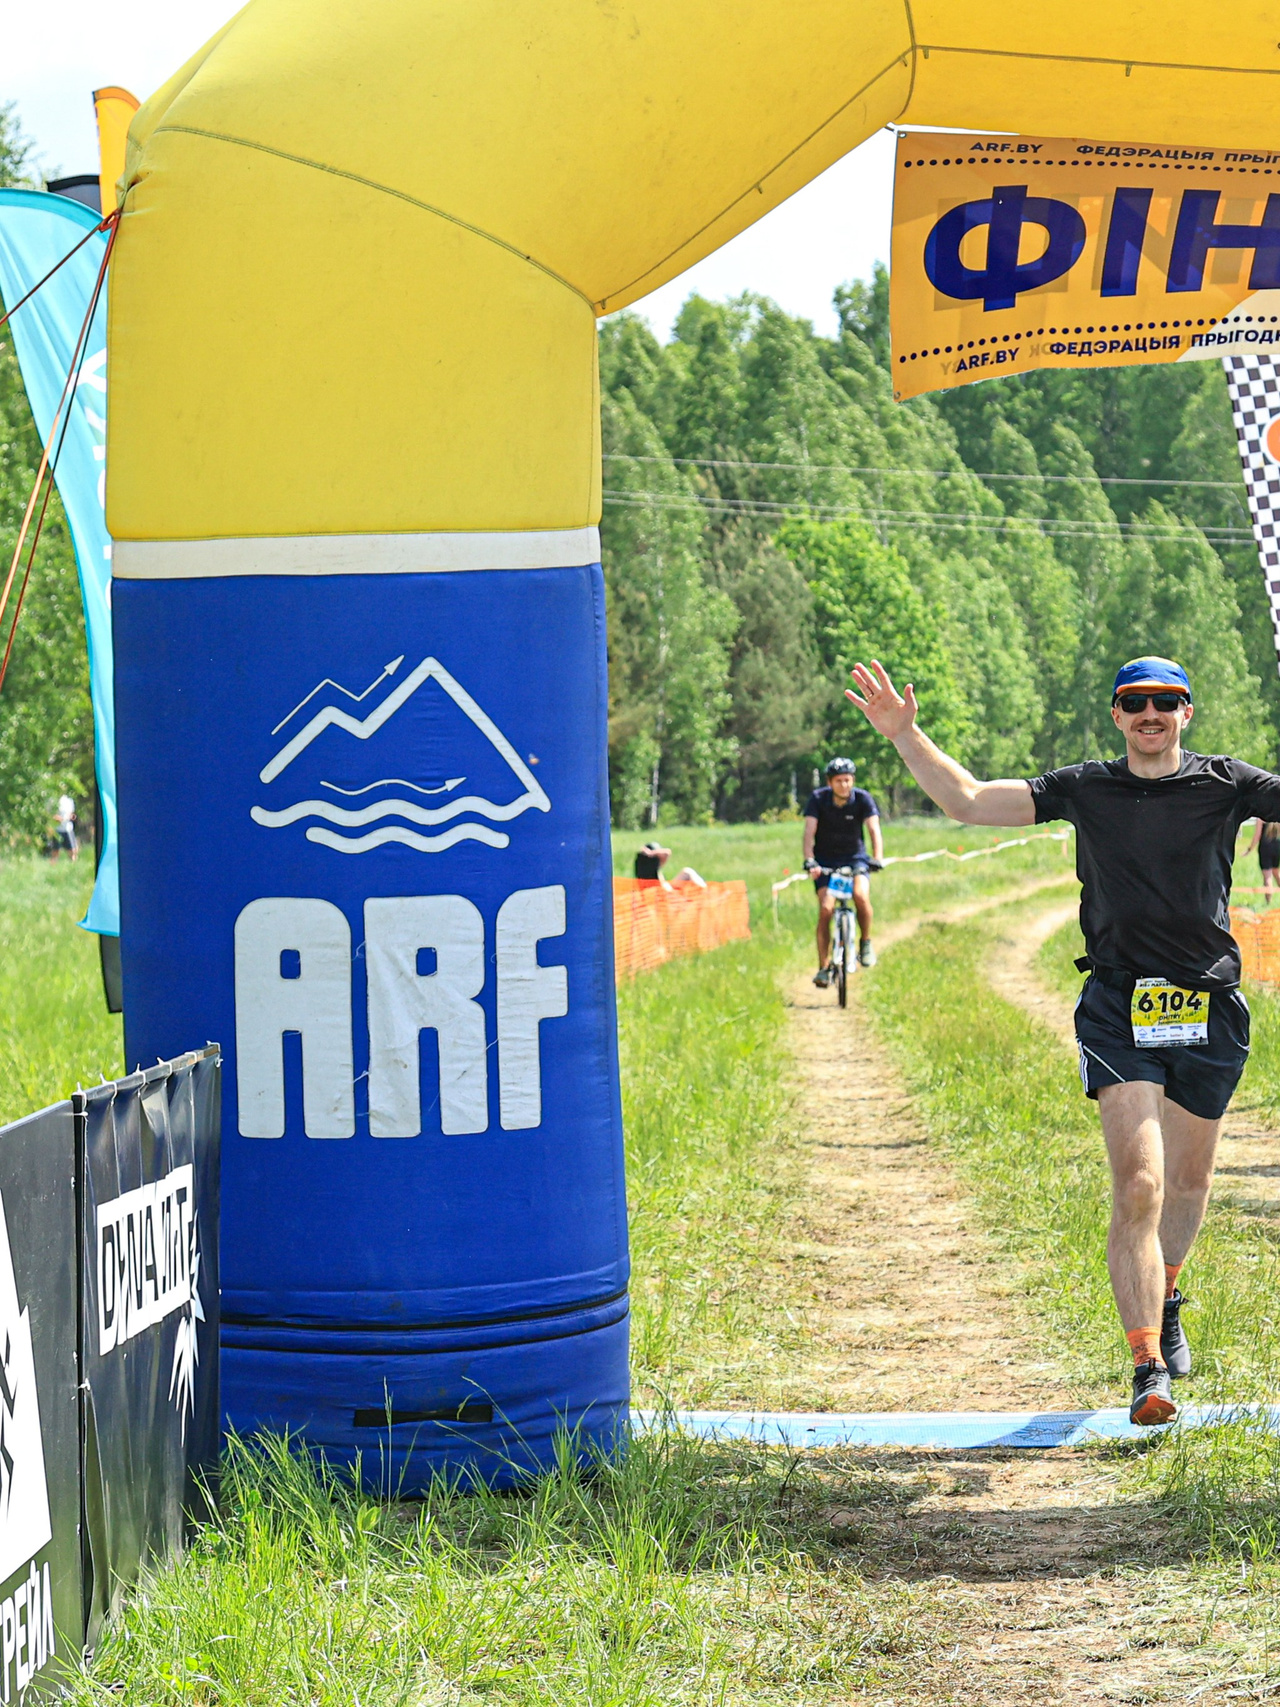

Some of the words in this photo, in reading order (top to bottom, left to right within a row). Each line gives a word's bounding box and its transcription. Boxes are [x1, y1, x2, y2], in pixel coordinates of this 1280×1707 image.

[969, 142, 1044, 153] ARF.BY
[1076, 144, 1215, 161] ФЕДЭРАЦЫЯ
[1049, 335, 1181, 357] ФЕДЭРАЦЫЯ
[955, 347, 1020, 373] ARF.BY
[234, 885, 568, 1139] ARF
[1138, 991, 1202, 1013] 6104
[0, 1559, 55, 1704] РЕЙЛ
